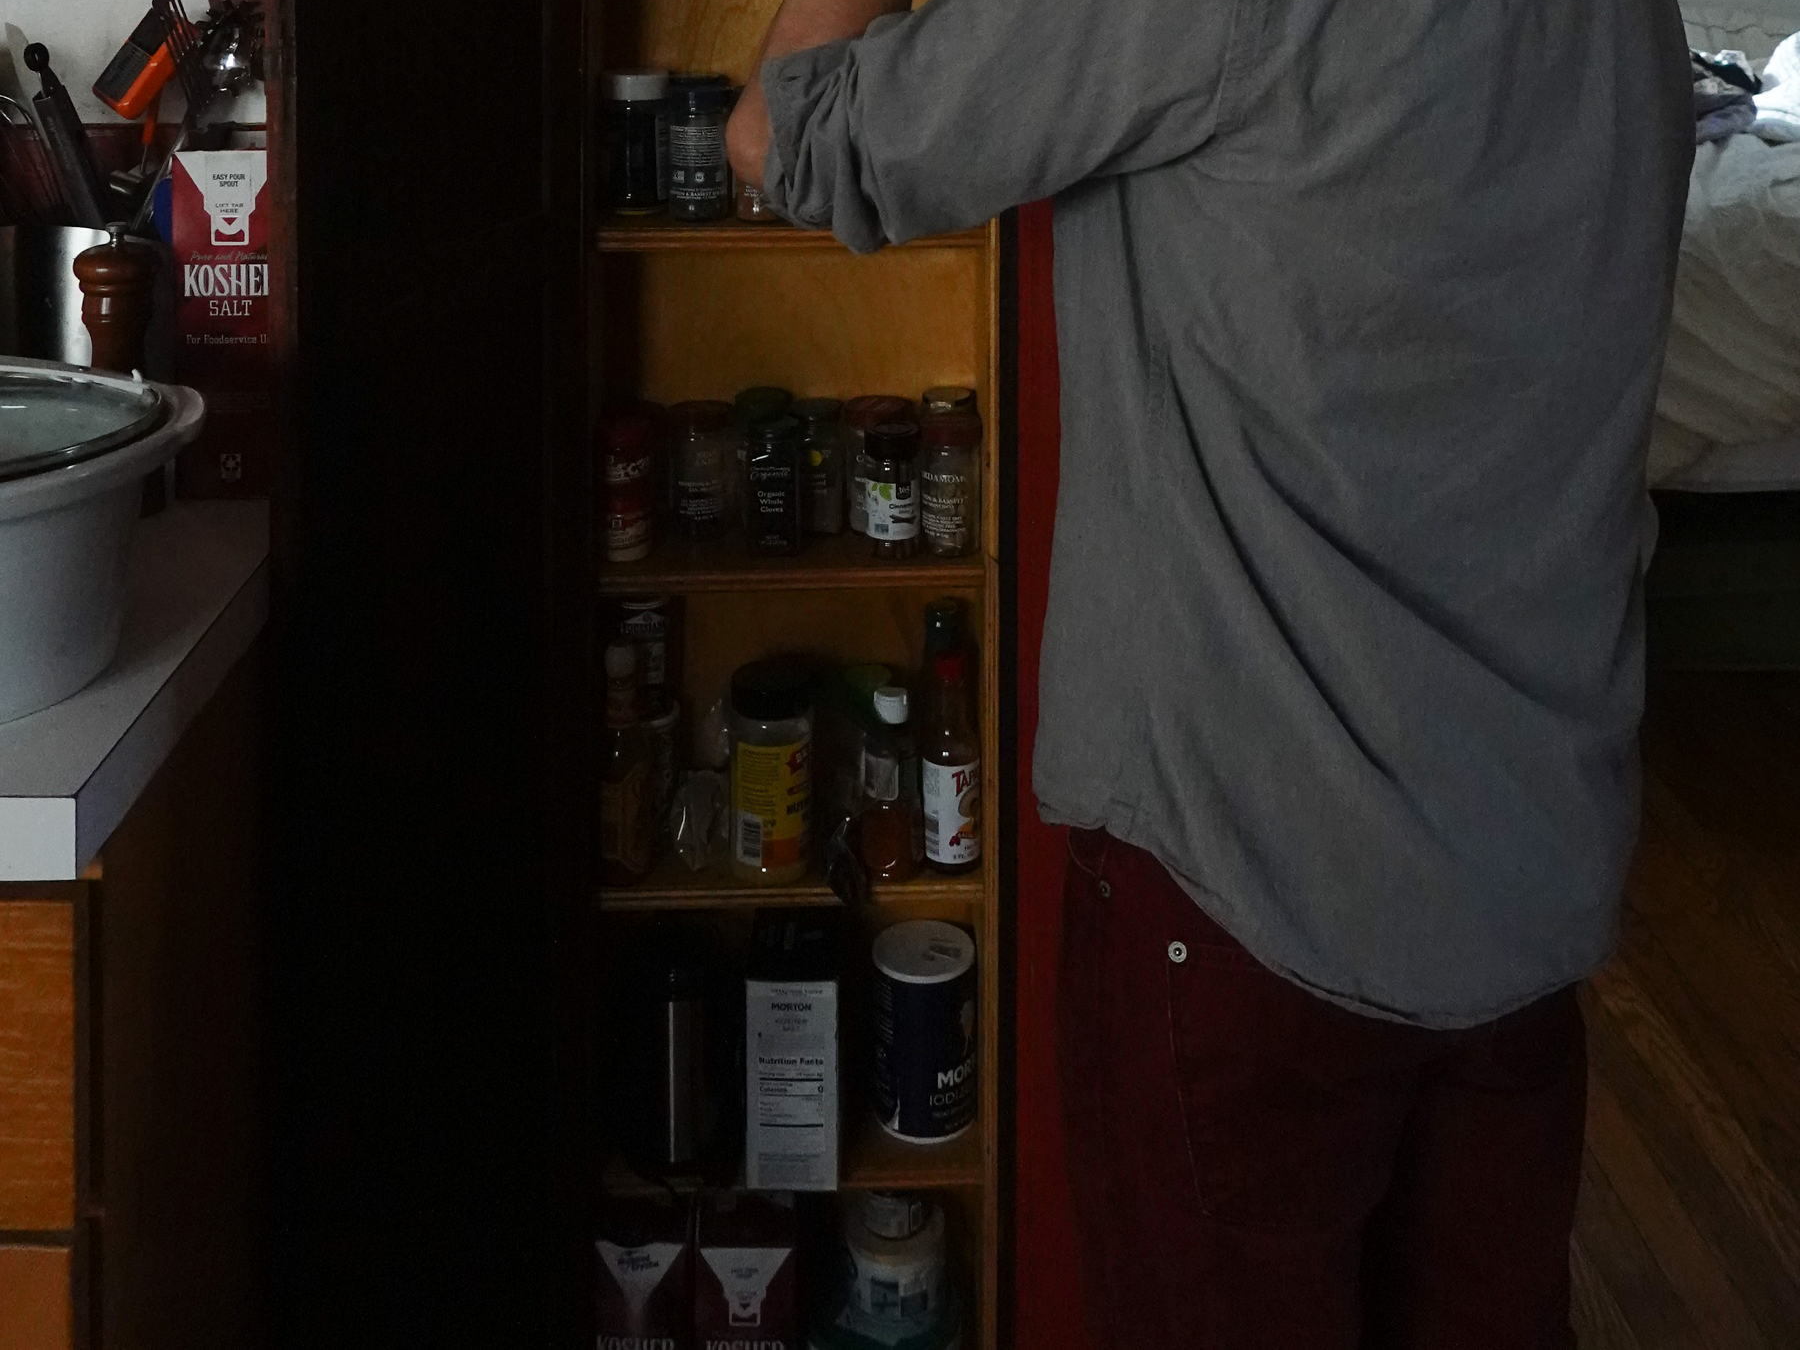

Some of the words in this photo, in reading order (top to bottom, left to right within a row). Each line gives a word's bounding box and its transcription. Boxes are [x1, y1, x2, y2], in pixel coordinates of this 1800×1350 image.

[212, 173, 228, 181] EASY
[229, 173, 246, 181] POUR
[219, 180, 239, 188] SPOUT
[190, 250, 213, 262] Pure
[214, 251, 234, 261] and
[209, 299, 253, 316] SALT
[186, 334, 202, 344] For
[203, 333, 257, 345] Foodservice
[260, 334, 268, 344] U
[757, 490, 786, 499] Organic
[760, 505, 784, 513] Cloves
[951, 765, 979, 798] TAP
[771, 1003, 812, 1011] MORTON
[758, 1057, 797, 1065] Nutrition
[799, 1057, 824, 1065] Facts
[817, 1085, 824, 1094] 0
